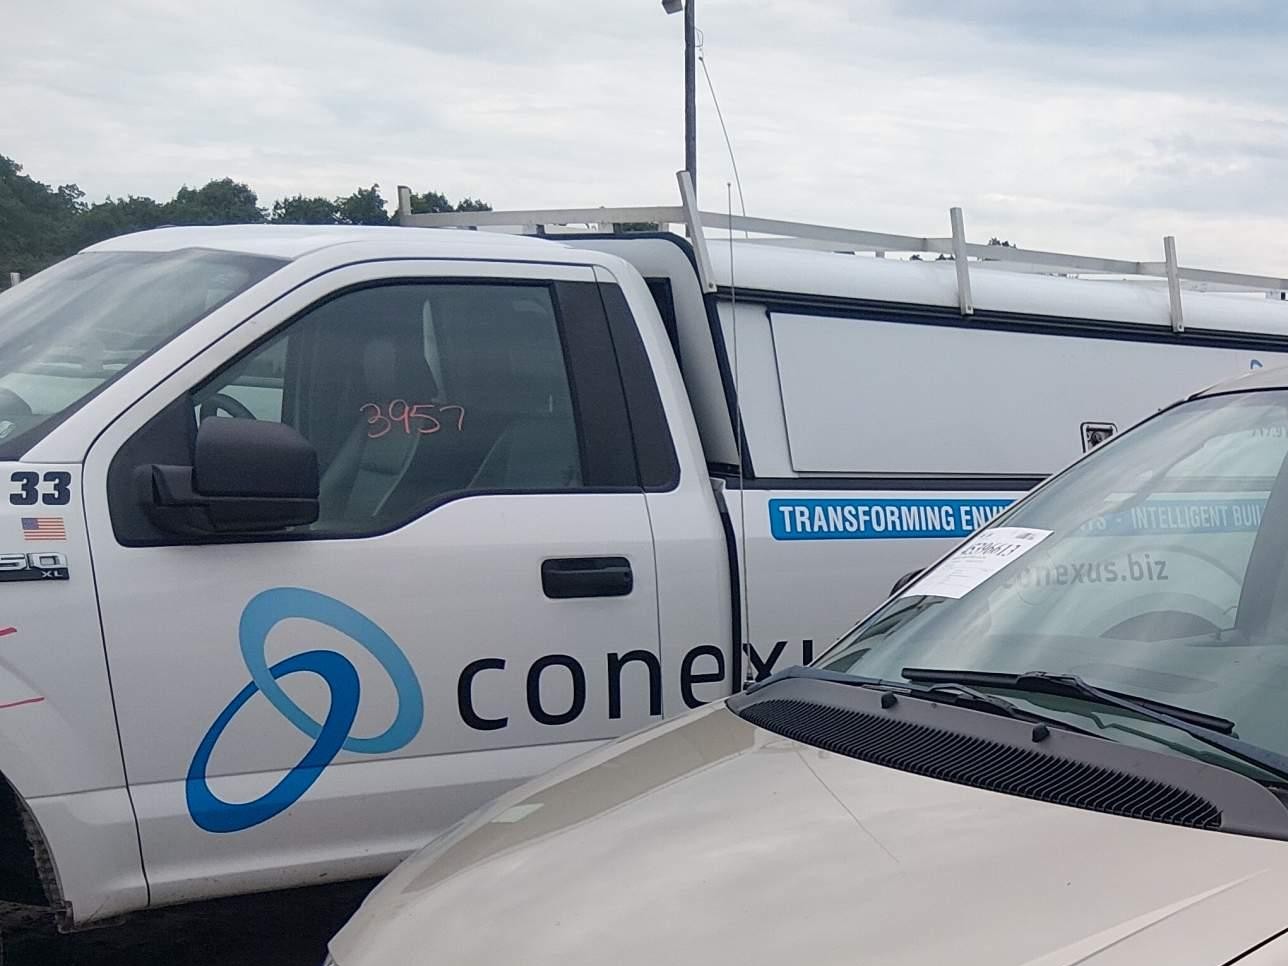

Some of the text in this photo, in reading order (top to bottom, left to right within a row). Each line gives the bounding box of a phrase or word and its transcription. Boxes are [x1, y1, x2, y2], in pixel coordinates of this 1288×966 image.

[359, 399, 465, 438] 3957
[9, 471, 72, 506] 33
[779, 505, 955, 533] TRANSFORMING
[1131, 505, 1228, 529] INTELLIGENT
[41, 570, 64, 578] XL
[457, 639, 814, 731] conex
